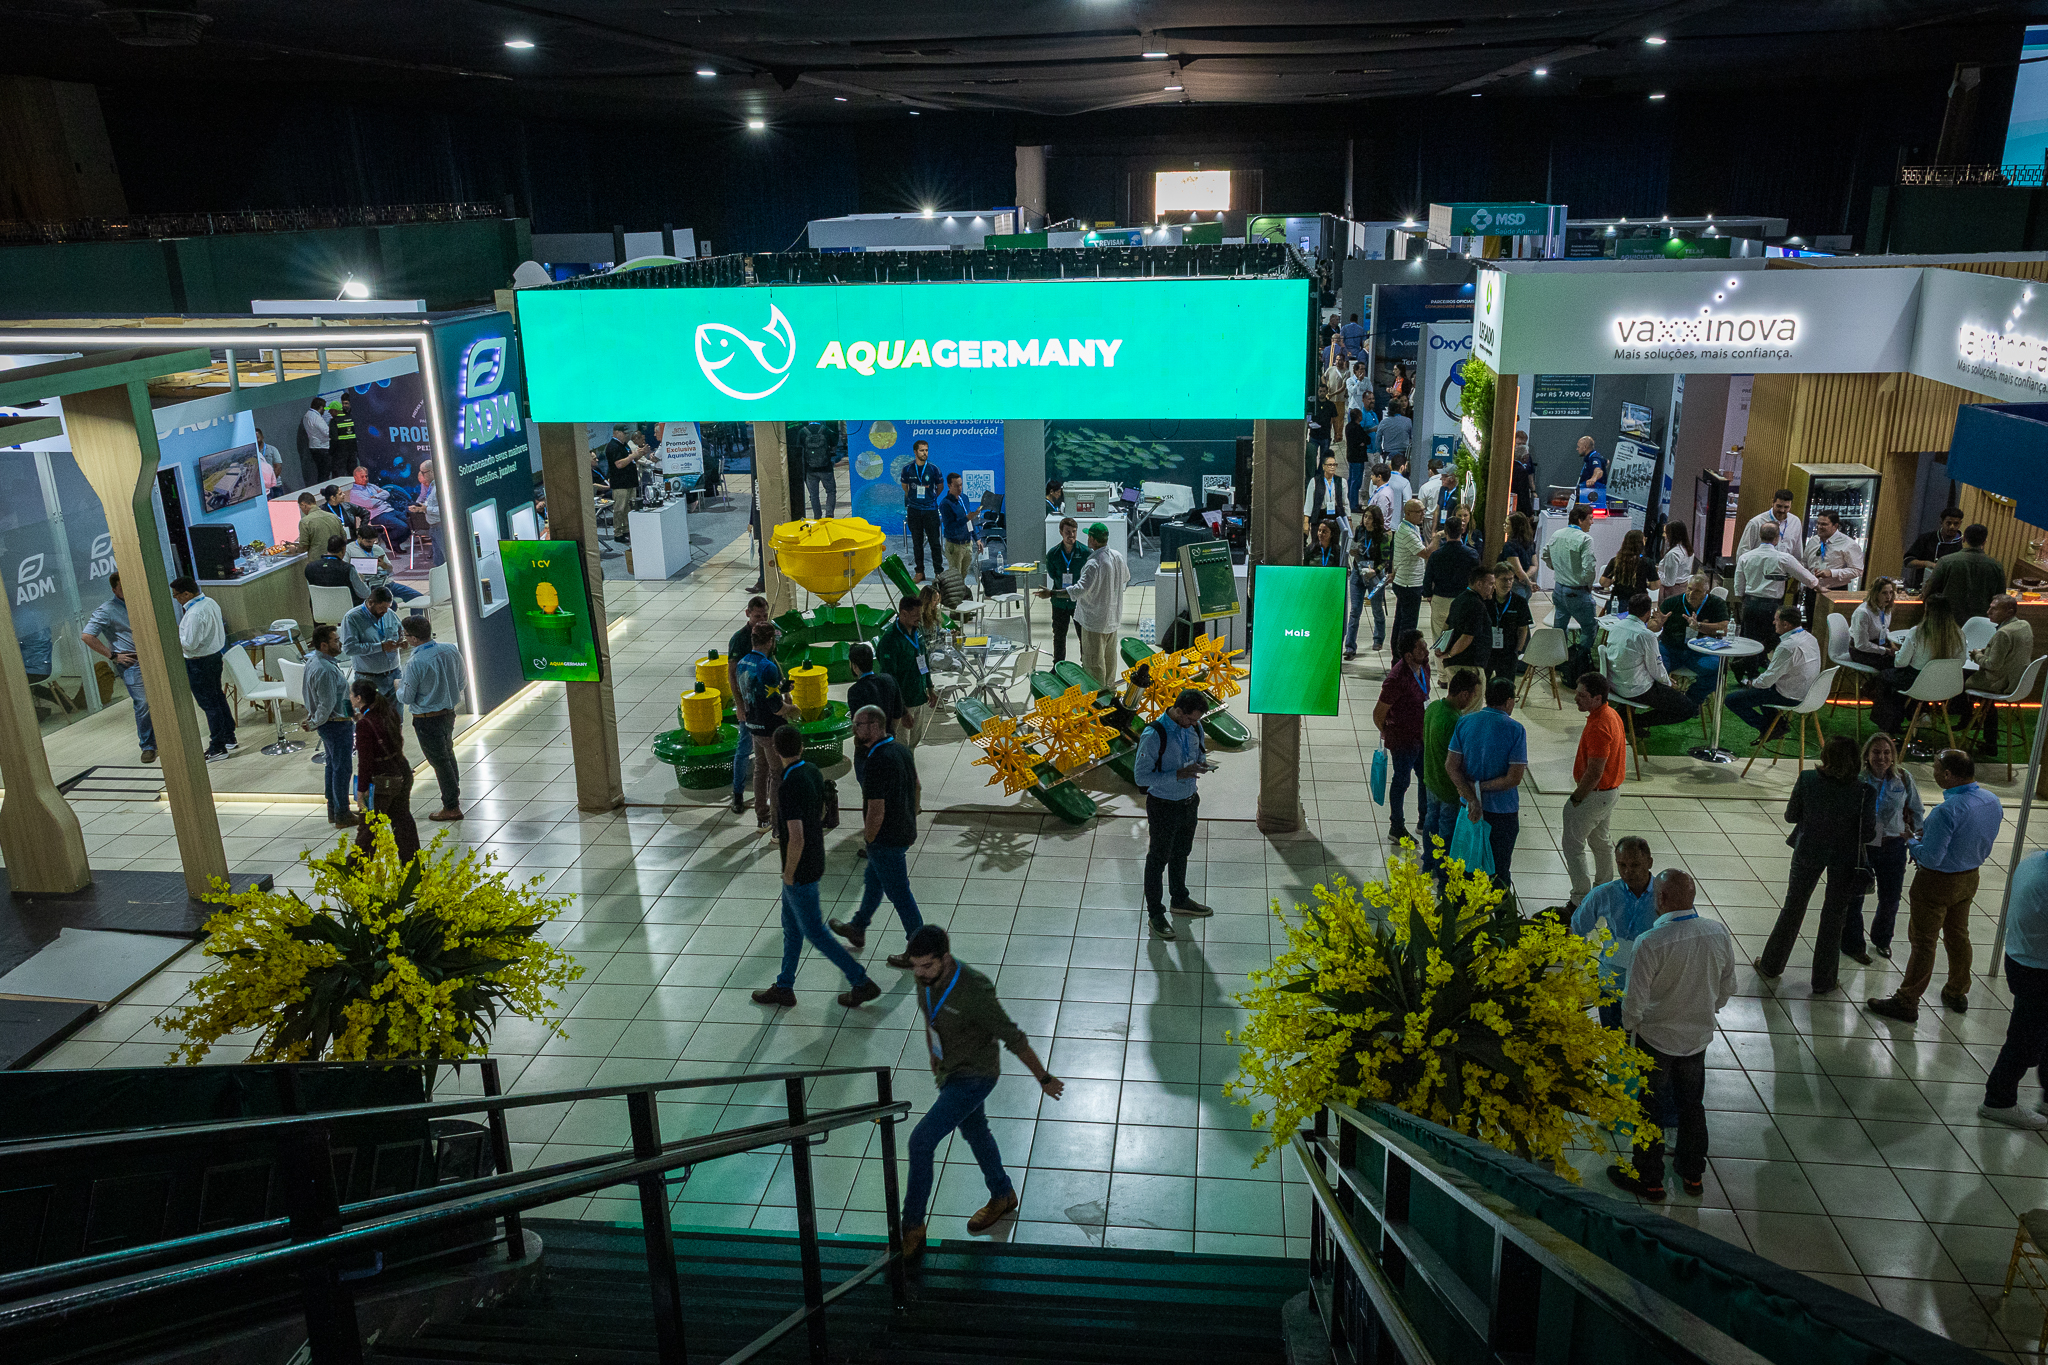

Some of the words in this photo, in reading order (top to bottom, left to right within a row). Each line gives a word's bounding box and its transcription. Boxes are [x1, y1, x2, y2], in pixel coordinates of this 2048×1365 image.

[1495, 213, 1526, 226] MSD
[1617, 308, 1796, 342] vaxxinova
[816, 338, 1123, 376] AQUAGERMANY
[1614, 348, 1641, 359] Mais
[1644, 348, 1697, 361] soluções,
[1701, 348, 1728, 359] mais
[1731, 347, 1793, 361] confiança.
[1957, 360, 1971, 374] Mais
[1972, 363, 1997, 381] soluções,
[1999, 372, 2013, 385] mais
[463, 391, 521, 450] ADM
[912, 428, 934, 437] para
[952, 426, 998, 437] produção!
[537, 560, 550, 568] CV
[16, 576, 56, 606] ADM
[1284, 629, 1310, 637] Mais
